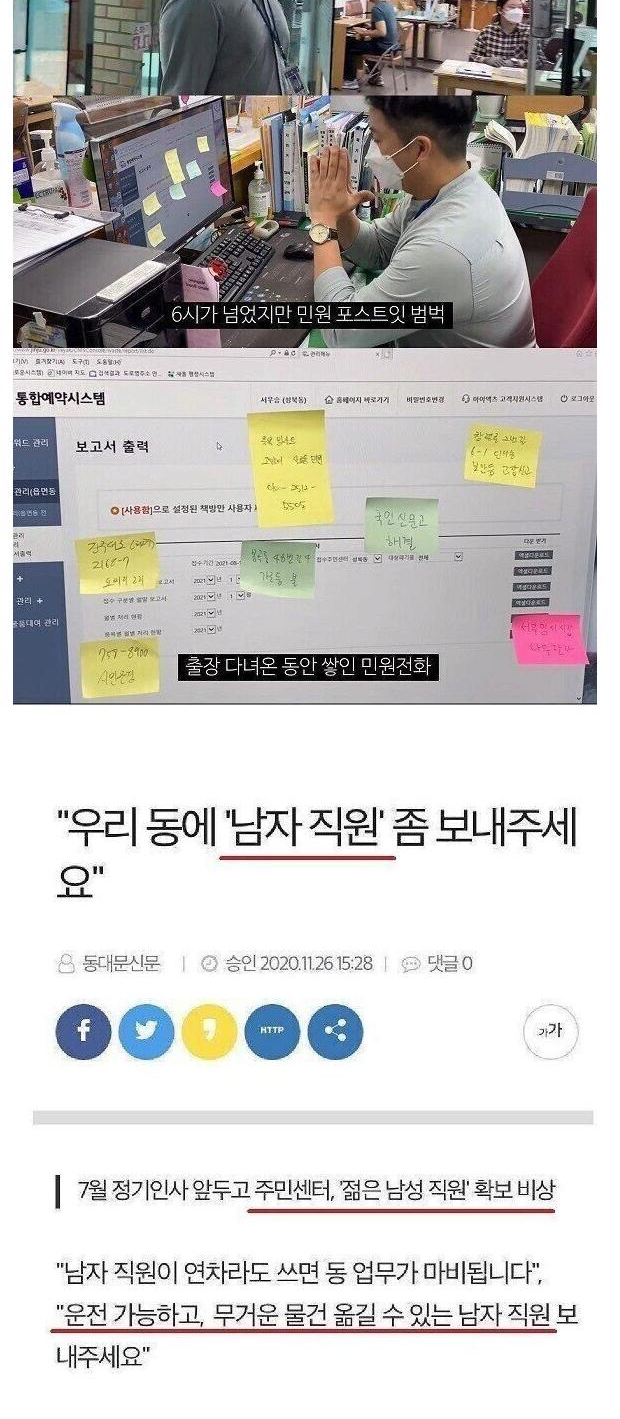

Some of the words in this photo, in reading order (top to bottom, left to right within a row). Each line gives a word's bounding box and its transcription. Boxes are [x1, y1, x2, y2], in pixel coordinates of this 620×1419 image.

[16, 392, 105, 405] 통합예약시스템
[33, 438, 48, 447] 관리
[76, 441, 116, 453] 보고서
[123, 441, 148, 453] 출력
[122, 507, 169, 516] [사용함]으로
[173, 505, 197, 514] 설정된
[228, 504, 252, 512] 사용자
[17, 597, 31, 605] 관리
